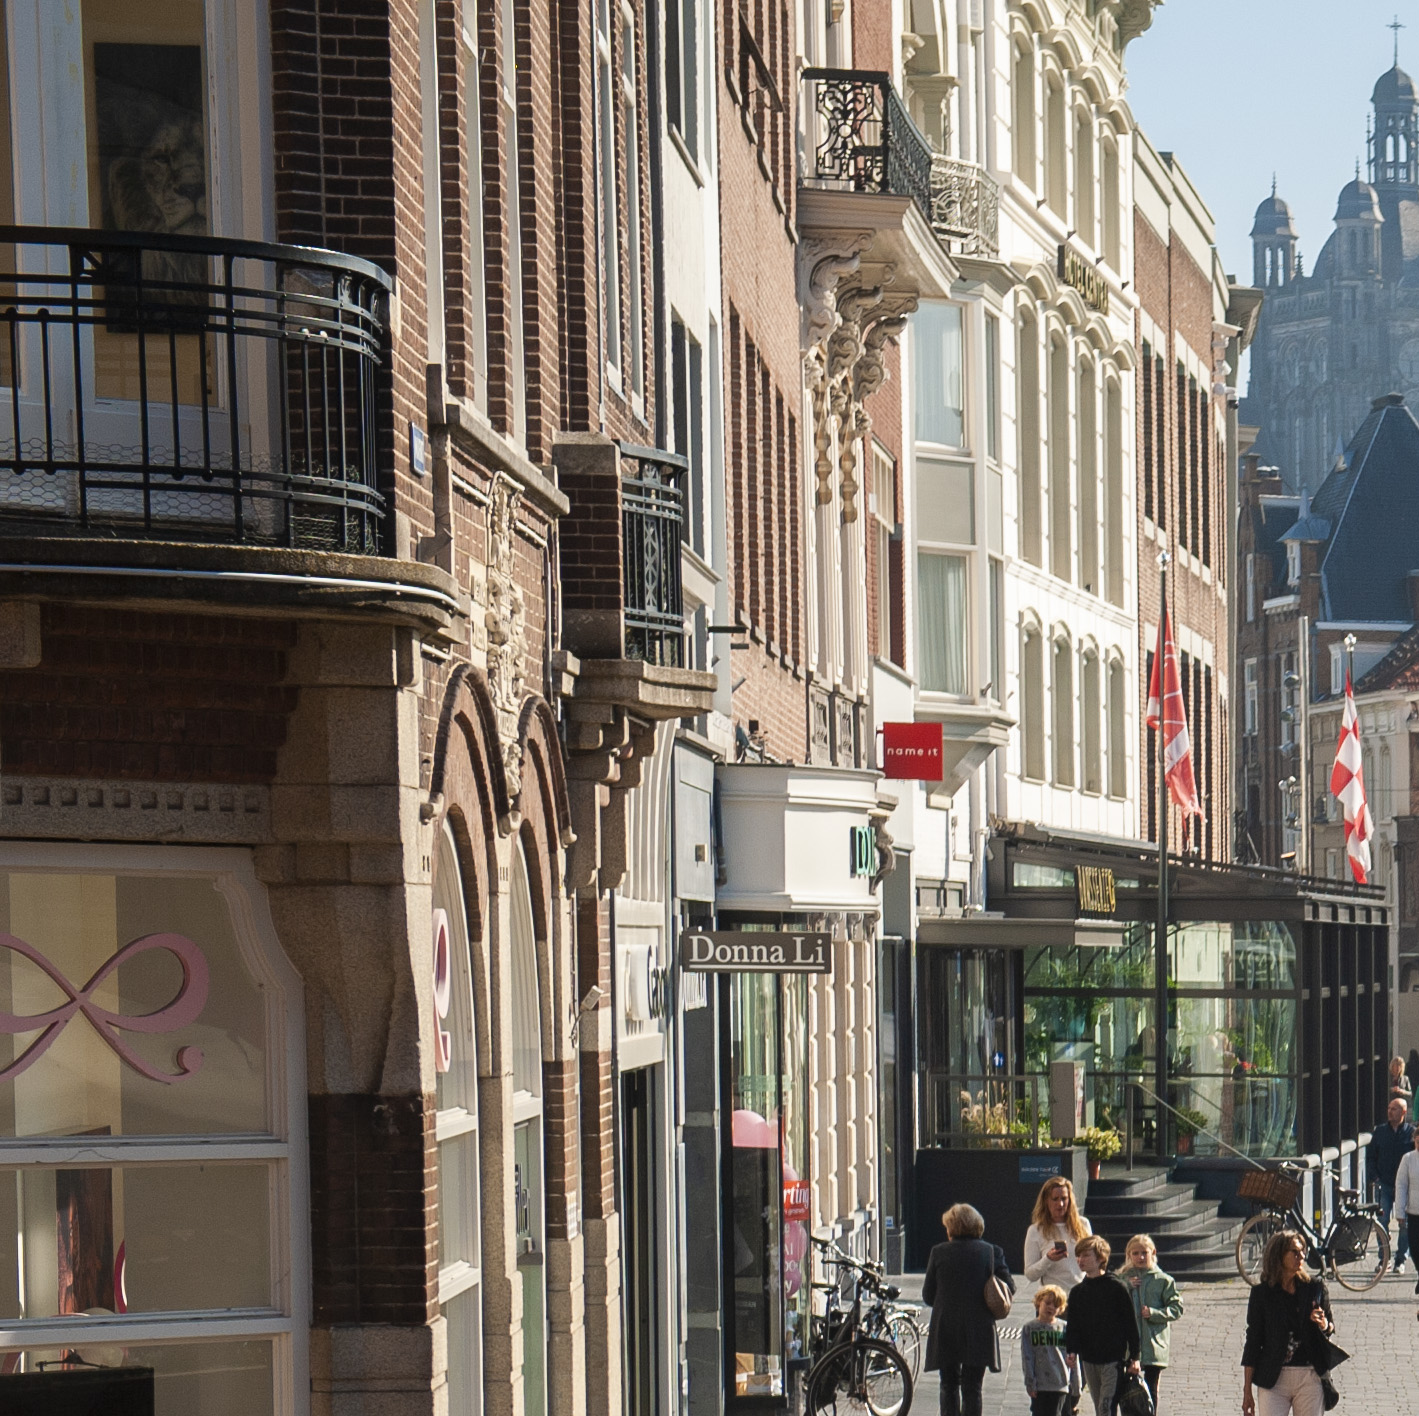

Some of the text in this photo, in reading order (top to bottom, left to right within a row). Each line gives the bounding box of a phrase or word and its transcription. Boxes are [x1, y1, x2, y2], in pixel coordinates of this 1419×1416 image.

[887, 746, 939, 757] name it
[689, 935, 825, 963] Donna Li
[783, 1184, 809, 1209] rting
